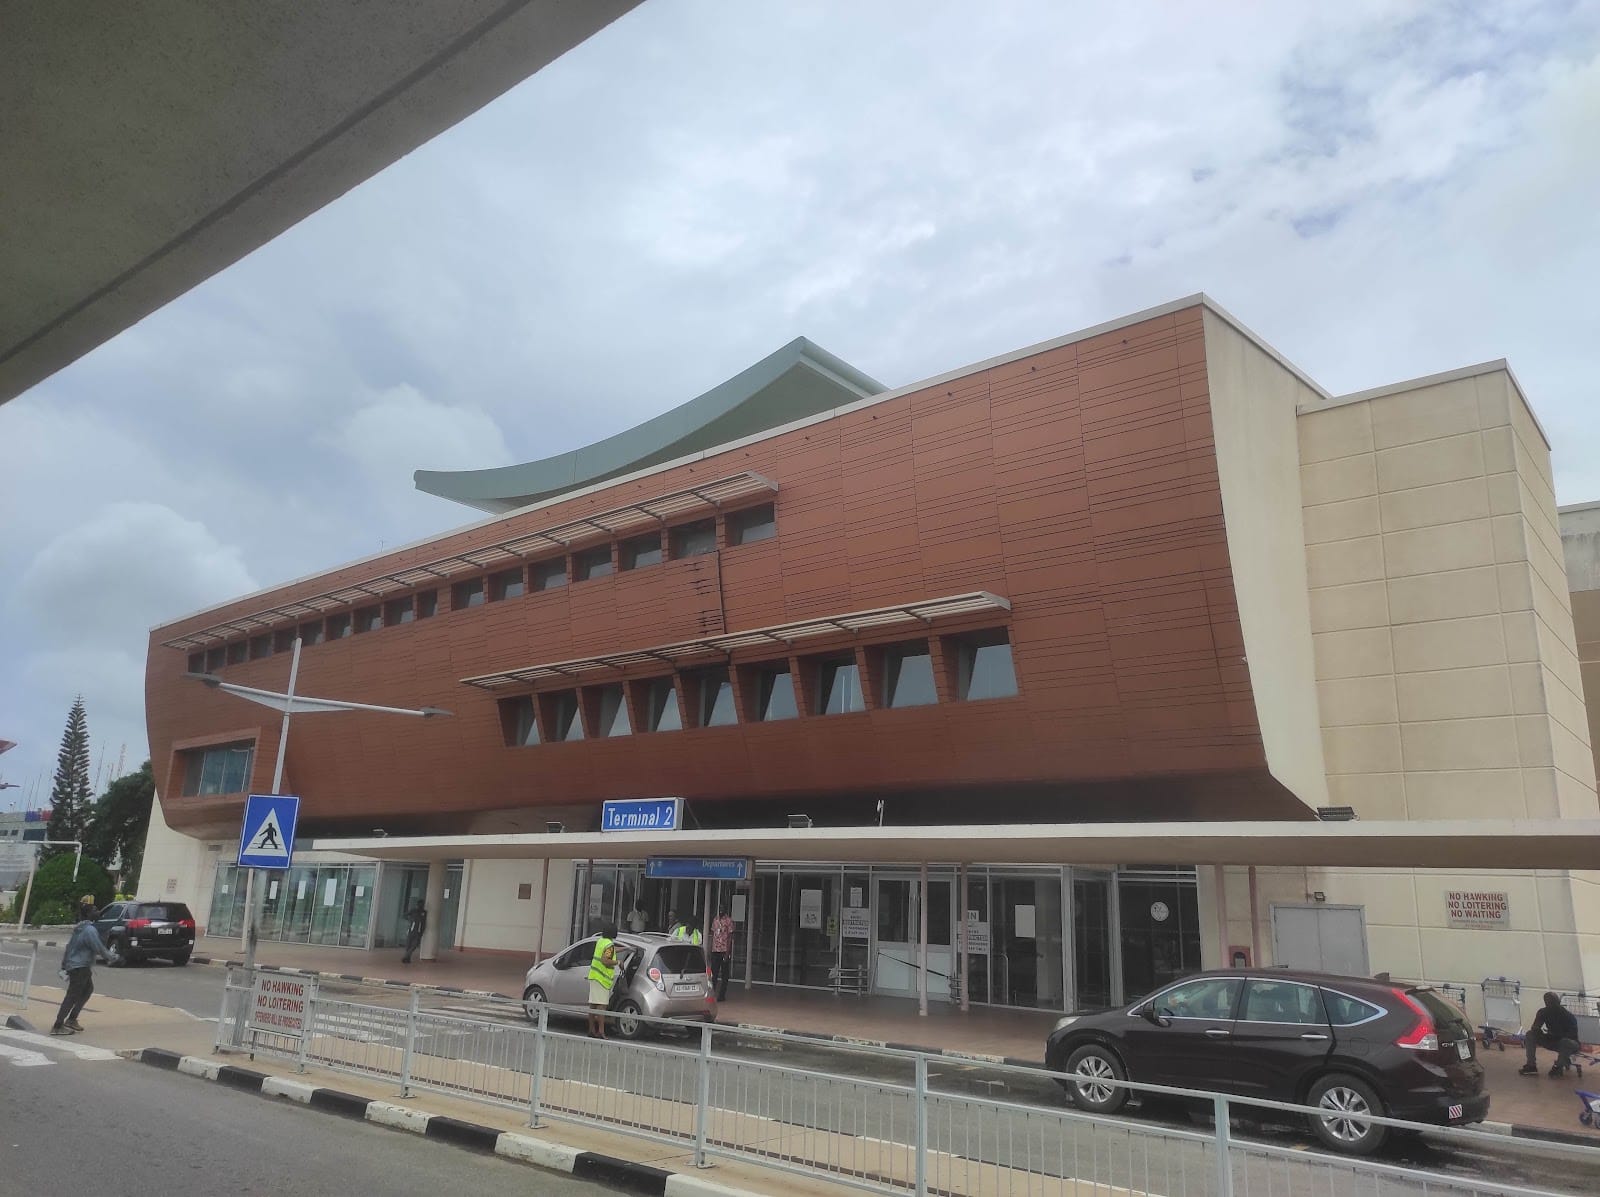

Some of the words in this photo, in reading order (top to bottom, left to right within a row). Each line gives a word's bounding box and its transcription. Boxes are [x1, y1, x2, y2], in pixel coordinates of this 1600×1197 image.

[608, 806, 660, 827] Terminal
[663, 806, 673, 826] 2
[1449, 892, 1461, 900] NO
[1463, 893, 1503, 902] HAWKING
[1448, 901, 1460, 909] NO
[1462, 902, 1507, 911] LOITERING
[1451, 910, 1463, 918] NO
[1465, 910, 1501, 919] WAITING
[262, 979, 271, 992] NO
[272, 980, 304, 997] HAWKING
[257, 994, 268, 1007] NO
[268, 996, 304, 1013] LOITERING
